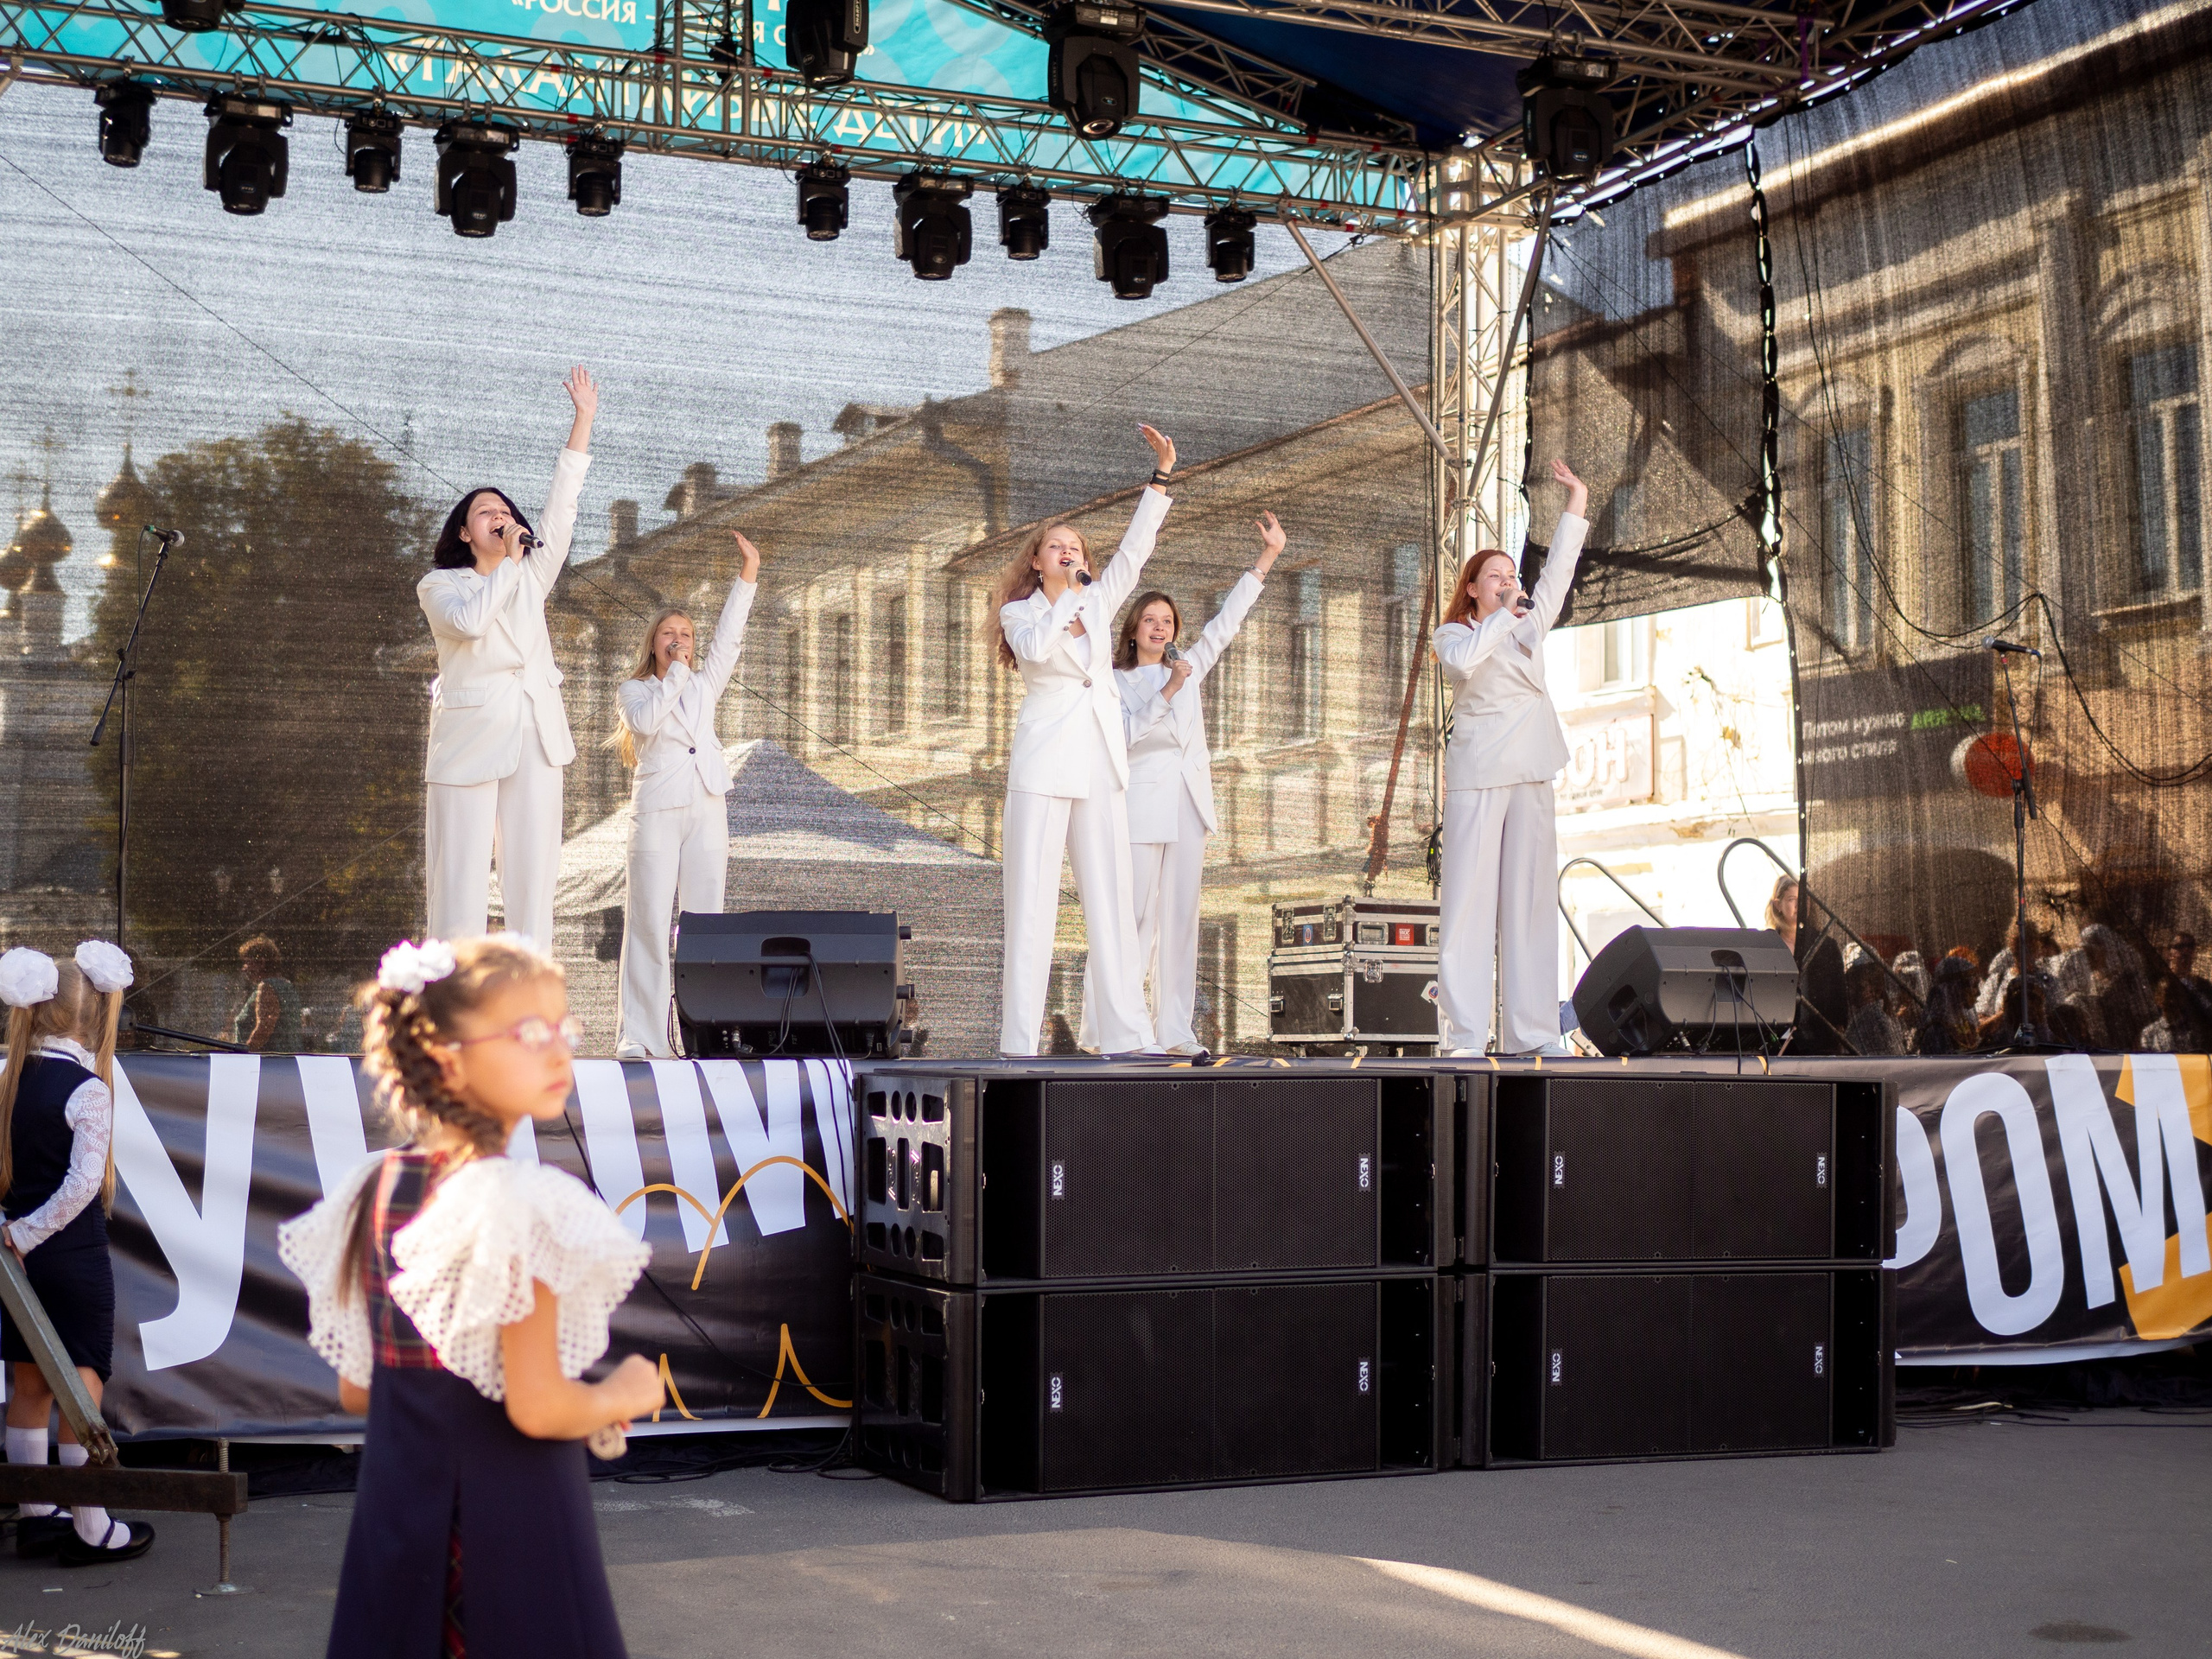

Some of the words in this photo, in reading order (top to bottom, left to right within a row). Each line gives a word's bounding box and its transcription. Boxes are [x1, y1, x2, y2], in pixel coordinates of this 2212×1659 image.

[1052, 1164, 1064, 1196] NEXO
[1359, 1158, 1370, 1188] NEXO
[1554, 1155, 1564, 1185] NEXO
[1816, 1156, 1826, 1185] NEXO
[1552, 1352, 1561, 1382] NEXO
[1814, 1345, 1823, 1374] NEXO
[1358, 1361, 1369, 1392] NEXO
[1051, 1376, 1062, 1408] NEXO
